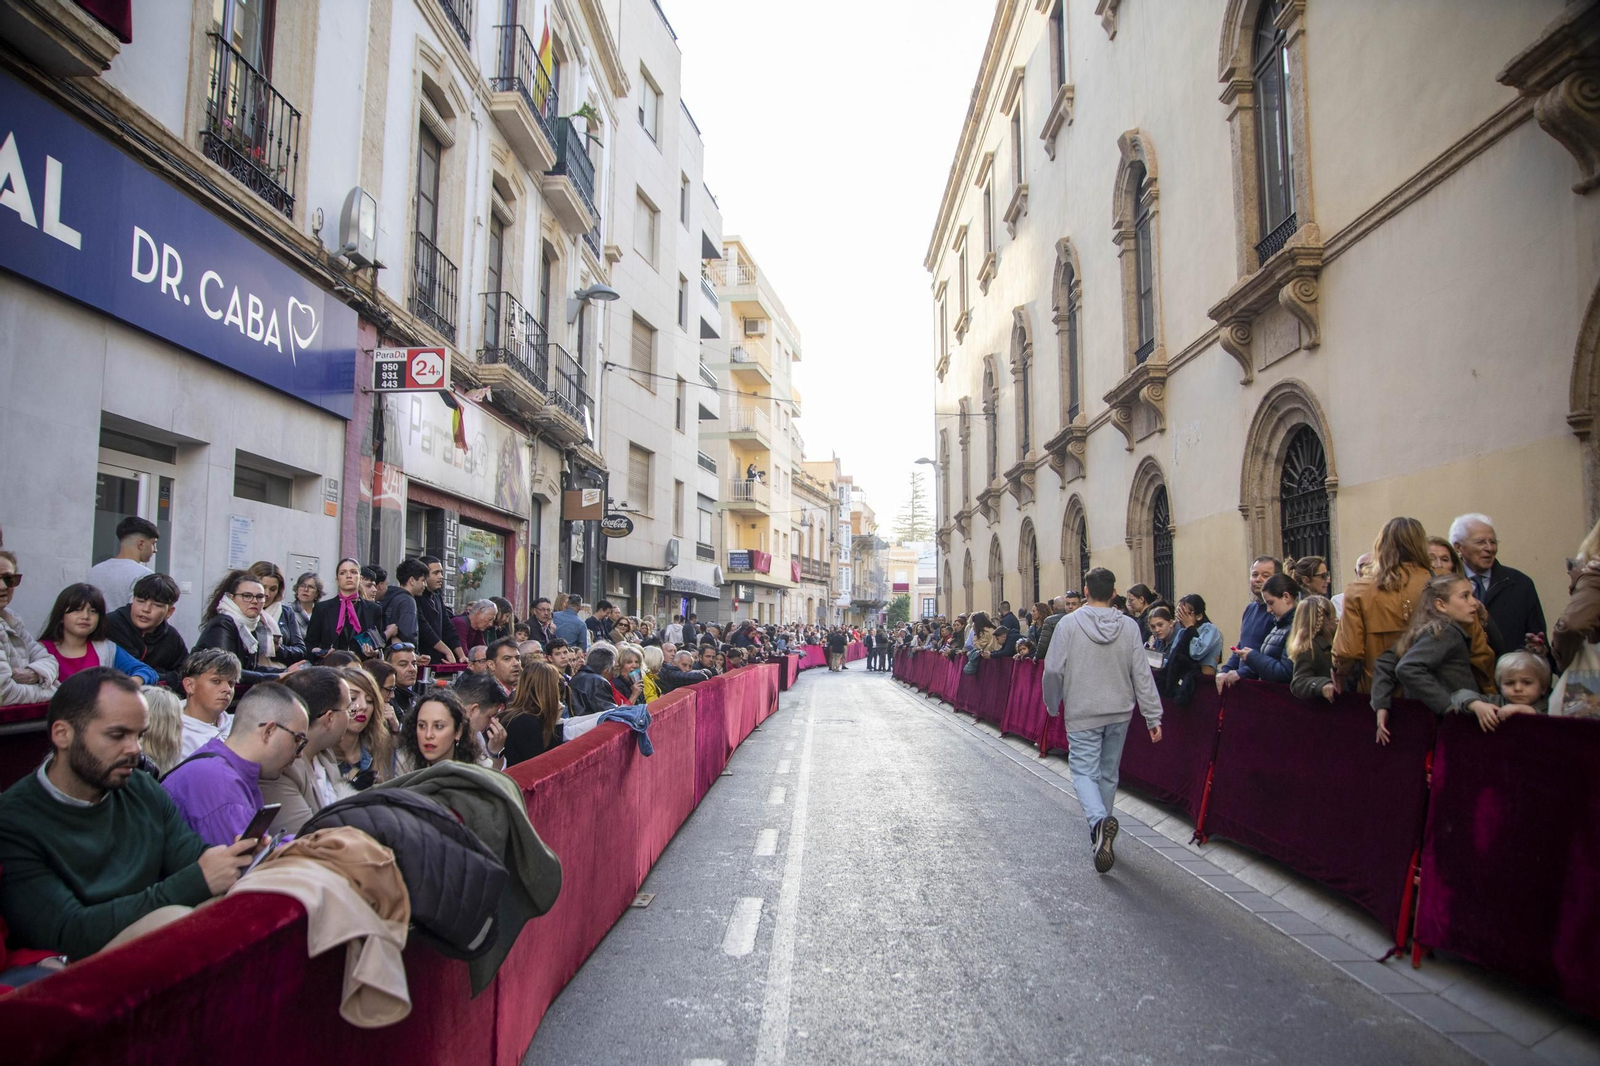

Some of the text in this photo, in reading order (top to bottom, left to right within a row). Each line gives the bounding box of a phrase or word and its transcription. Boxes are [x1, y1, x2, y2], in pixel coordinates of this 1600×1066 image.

[0, 131, 82, 250] AL
[131, 225, 283, 354] DR. CABA
[375, 350, 406, 359] ParaDa
[381, 363, 399, 371] 950
[415, 359, 441, 376] 24h
[381, 372, 399, 380] 931
